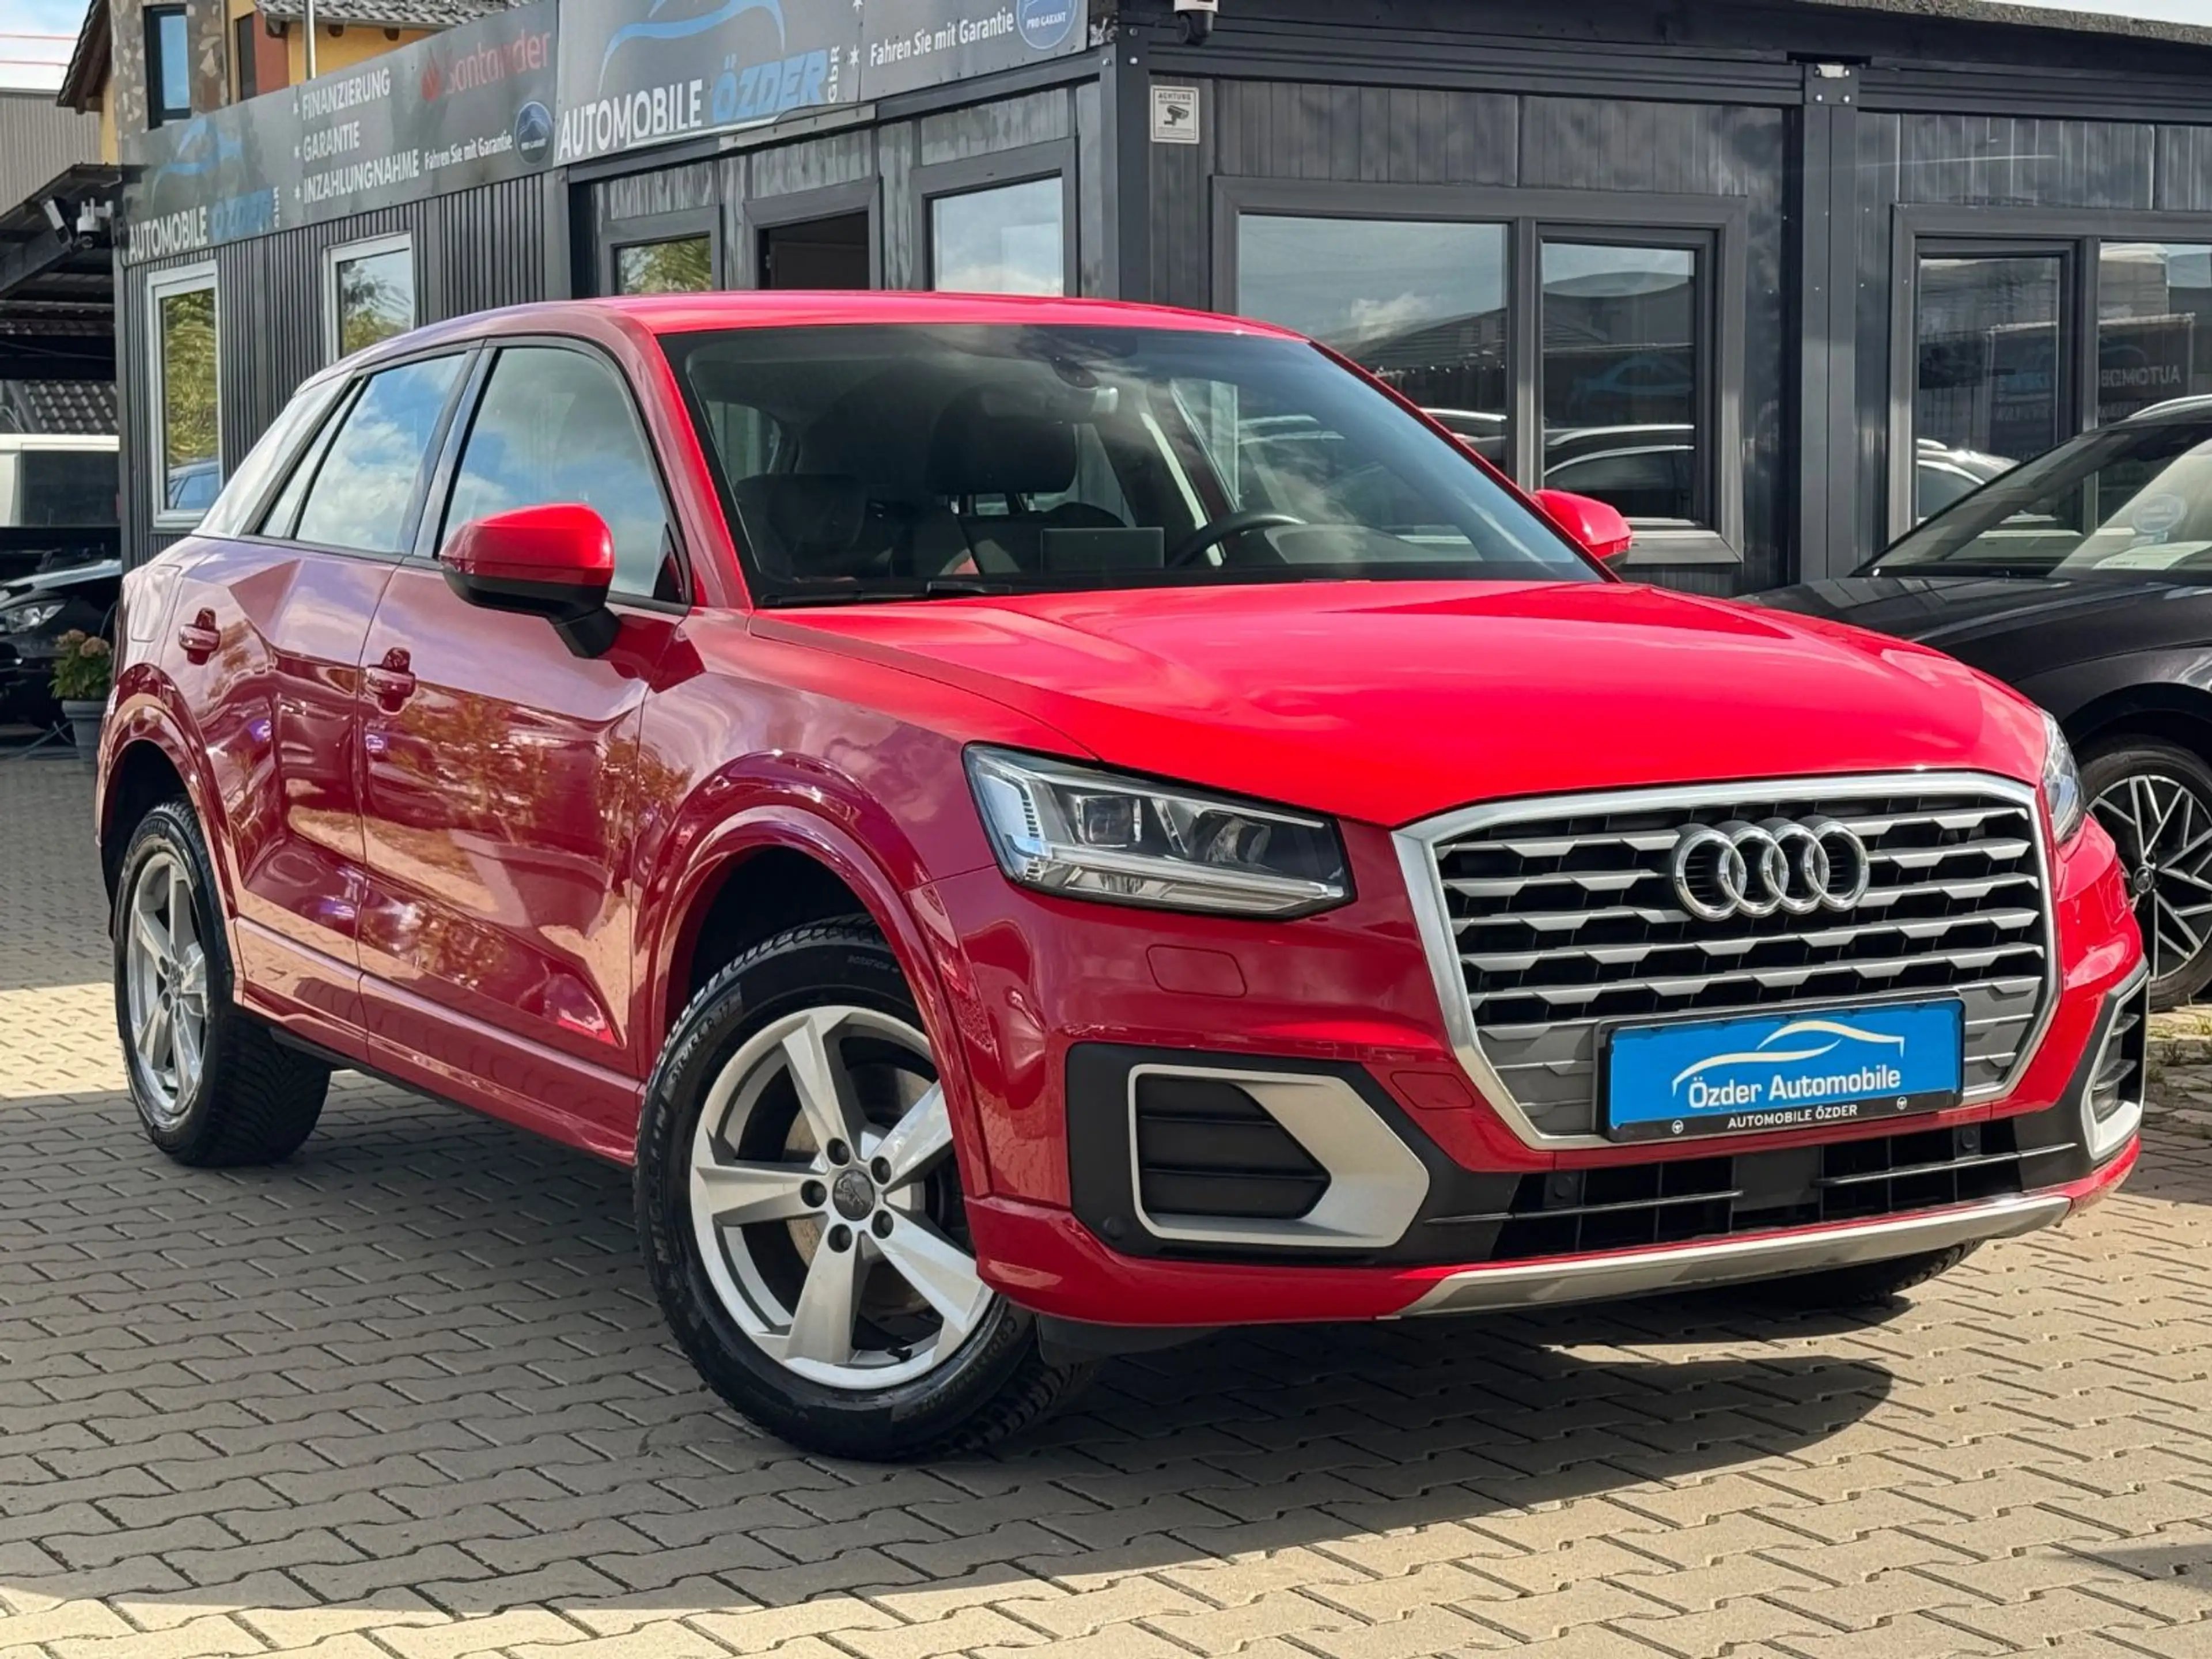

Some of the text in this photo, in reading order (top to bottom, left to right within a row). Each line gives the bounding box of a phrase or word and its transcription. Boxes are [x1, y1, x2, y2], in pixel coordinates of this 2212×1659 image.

[870, 6, 1014, 67] Fahren Sie mit Garantie
[302, 66, 391, 120] FINANZIERUNG
[558, 49, 828, 160] AUTOMOBILE ÖZDER
[304, 120, 360, 162] GARANTIE
[425, 149, 450, 171] Fahren
[450, 143, 463, 164] Sie
[464, 138, 478, 161] mit
[478, 129, 513, 158] Garantie
[304, 149, 420, 203] INZAHLUNGNAHME
[128, 206, 207, 262] AUTOMOBILE
[1689, 1064, 1901, 1109] Özder Automobile
[1728, 1104, 1858, 1130] AUTOMOBILE ÖZDER
